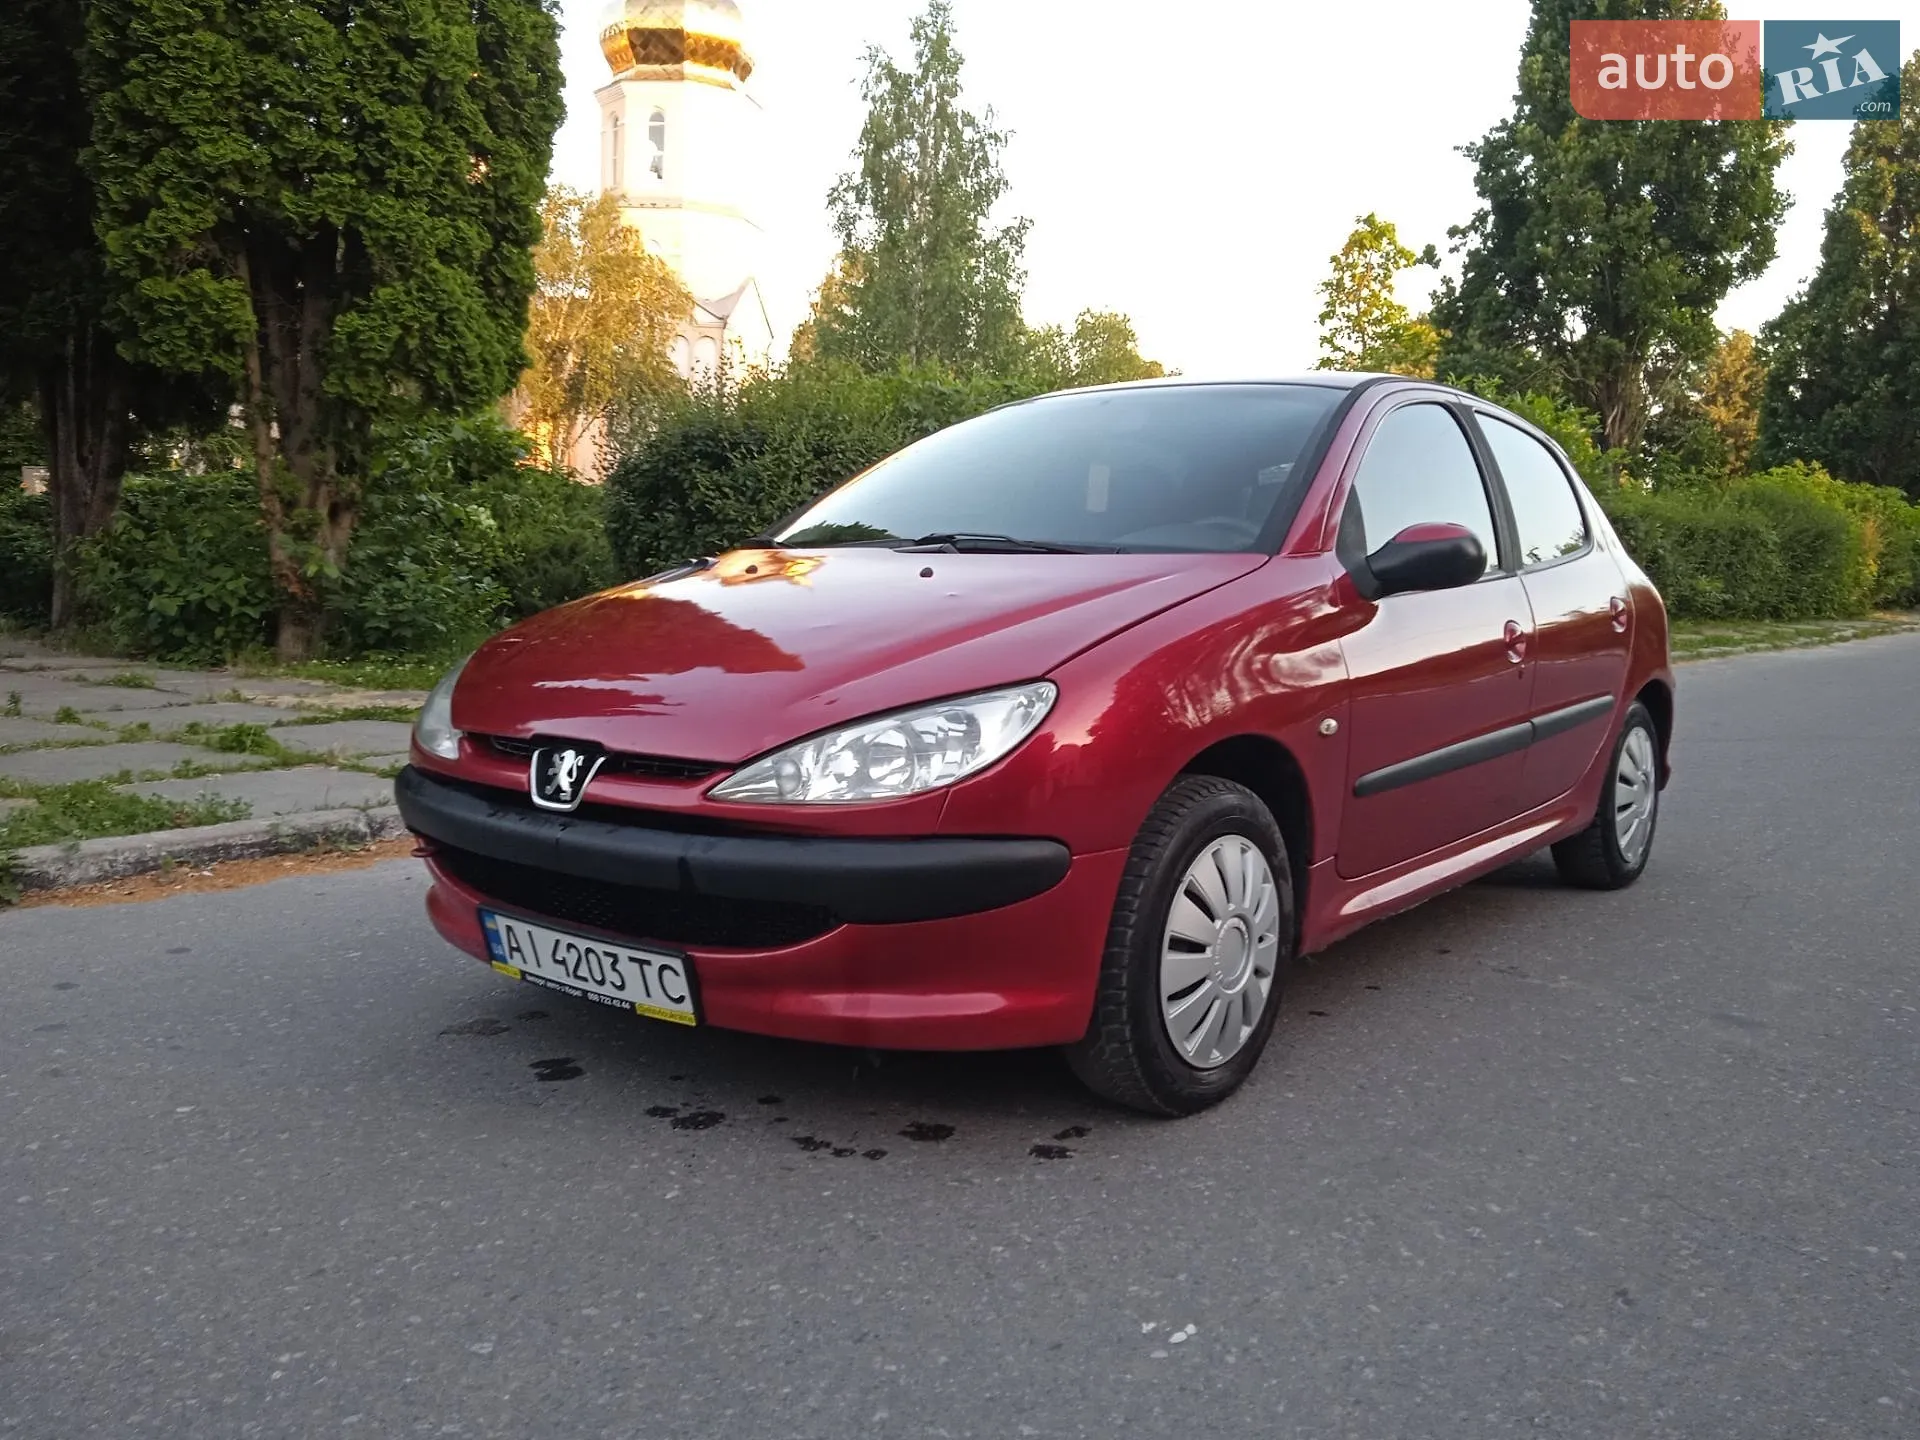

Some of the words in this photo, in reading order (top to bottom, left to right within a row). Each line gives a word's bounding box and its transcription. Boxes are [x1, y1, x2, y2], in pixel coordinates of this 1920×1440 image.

[504, 924, 541, 968] AI
[551, 938, 626, 991] 4203
[628, 956, 686, 1004] TC
